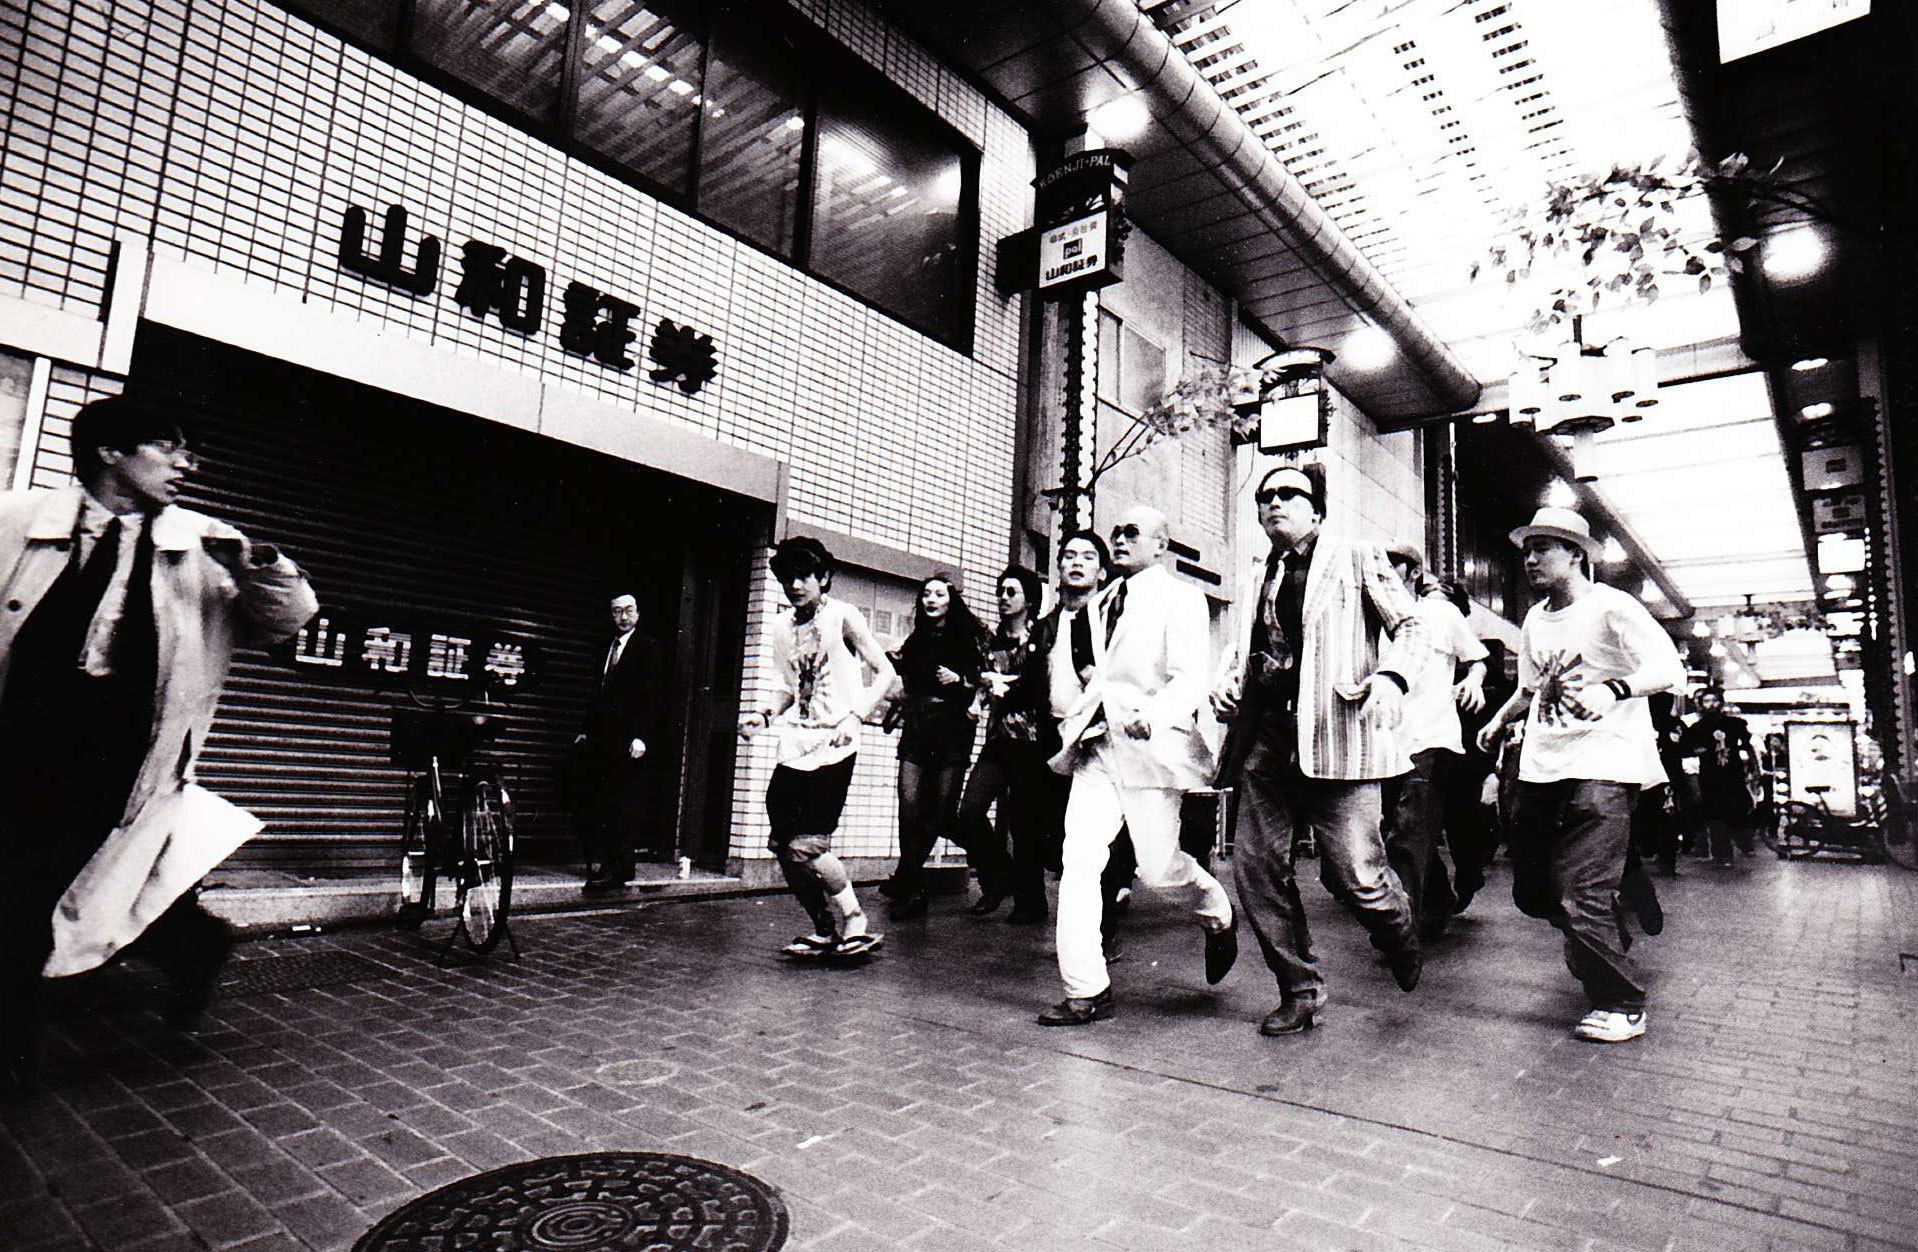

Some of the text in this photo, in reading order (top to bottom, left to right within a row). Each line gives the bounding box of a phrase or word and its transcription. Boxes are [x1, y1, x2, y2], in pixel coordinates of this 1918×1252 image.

[338, 204, 719, 395] 山和証券
[1045, 254, 1098, 280] 山和証券
[296, 618, 525, 685] 山和証券
